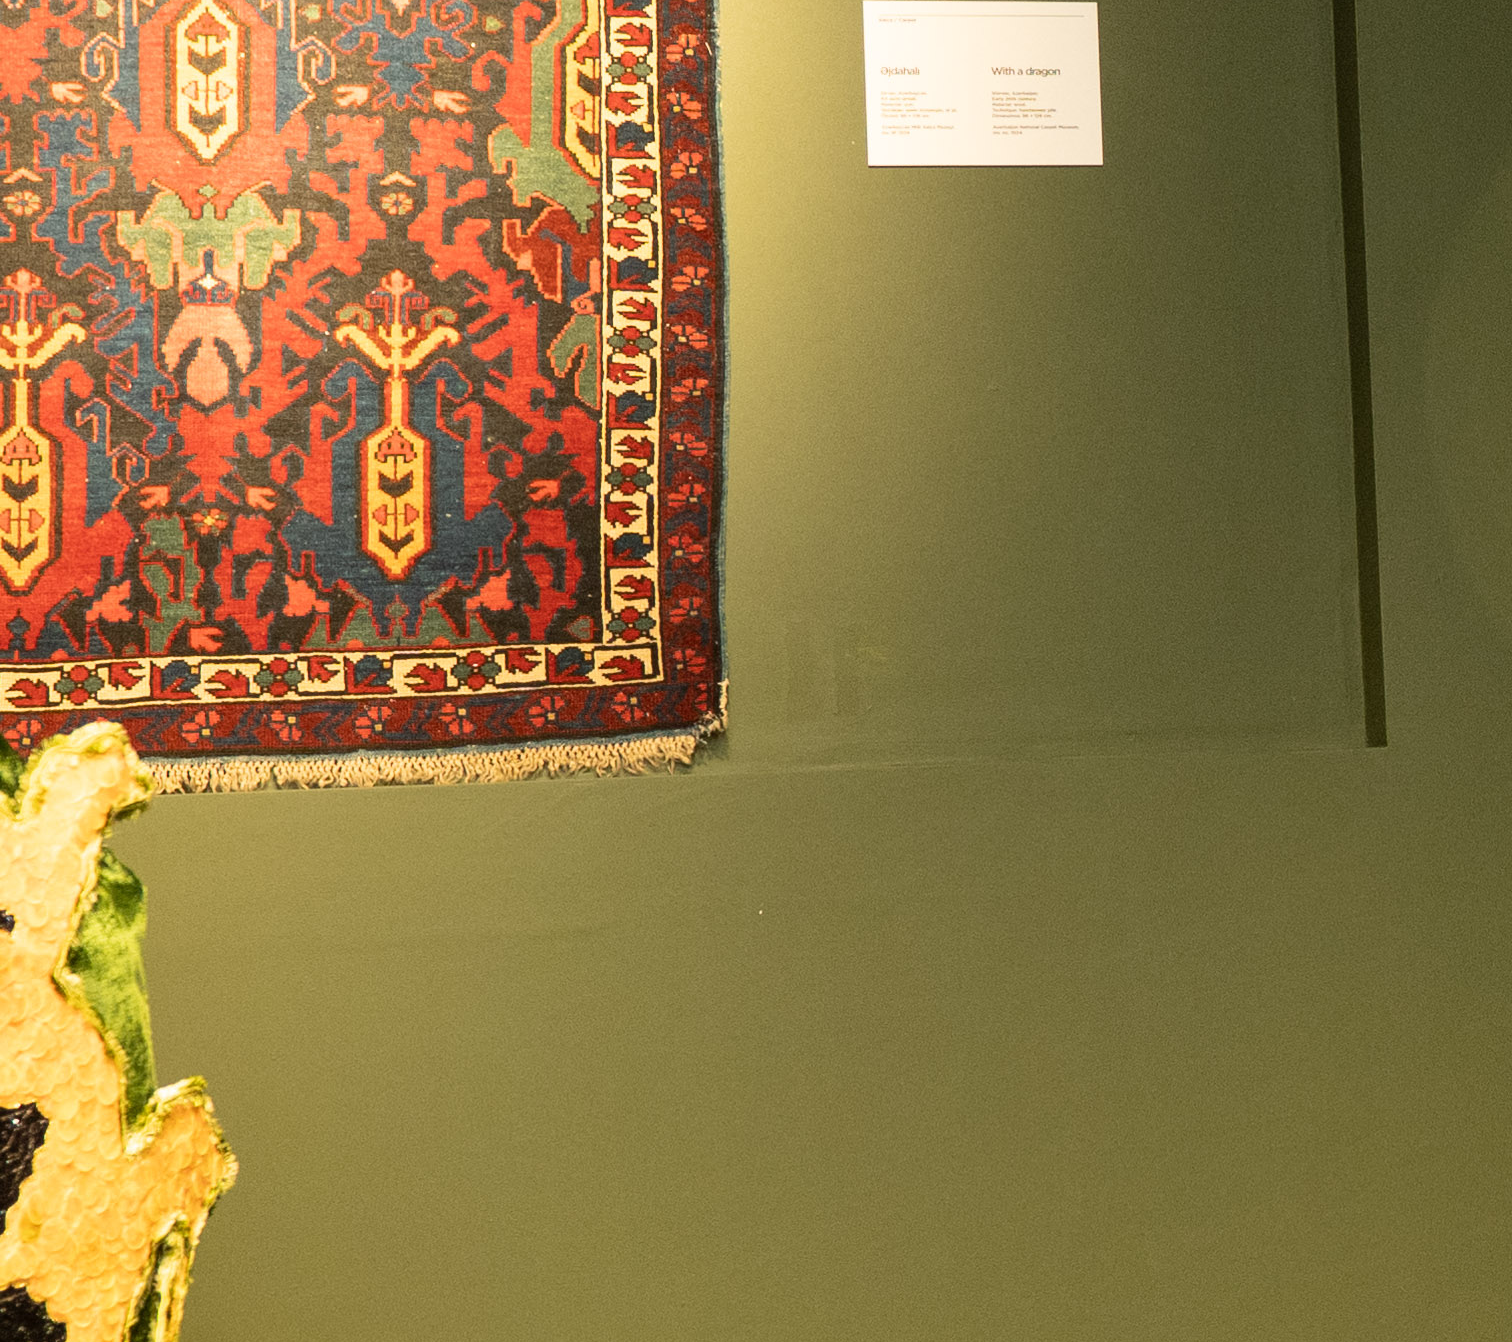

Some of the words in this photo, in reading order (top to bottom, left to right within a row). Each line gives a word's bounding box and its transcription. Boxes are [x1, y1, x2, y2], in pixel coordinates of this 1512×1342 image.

[991, 66, 1015, 76] With
[1017, 68, 1023, 76] a
[1025, 66, 1061, 77] dragon
